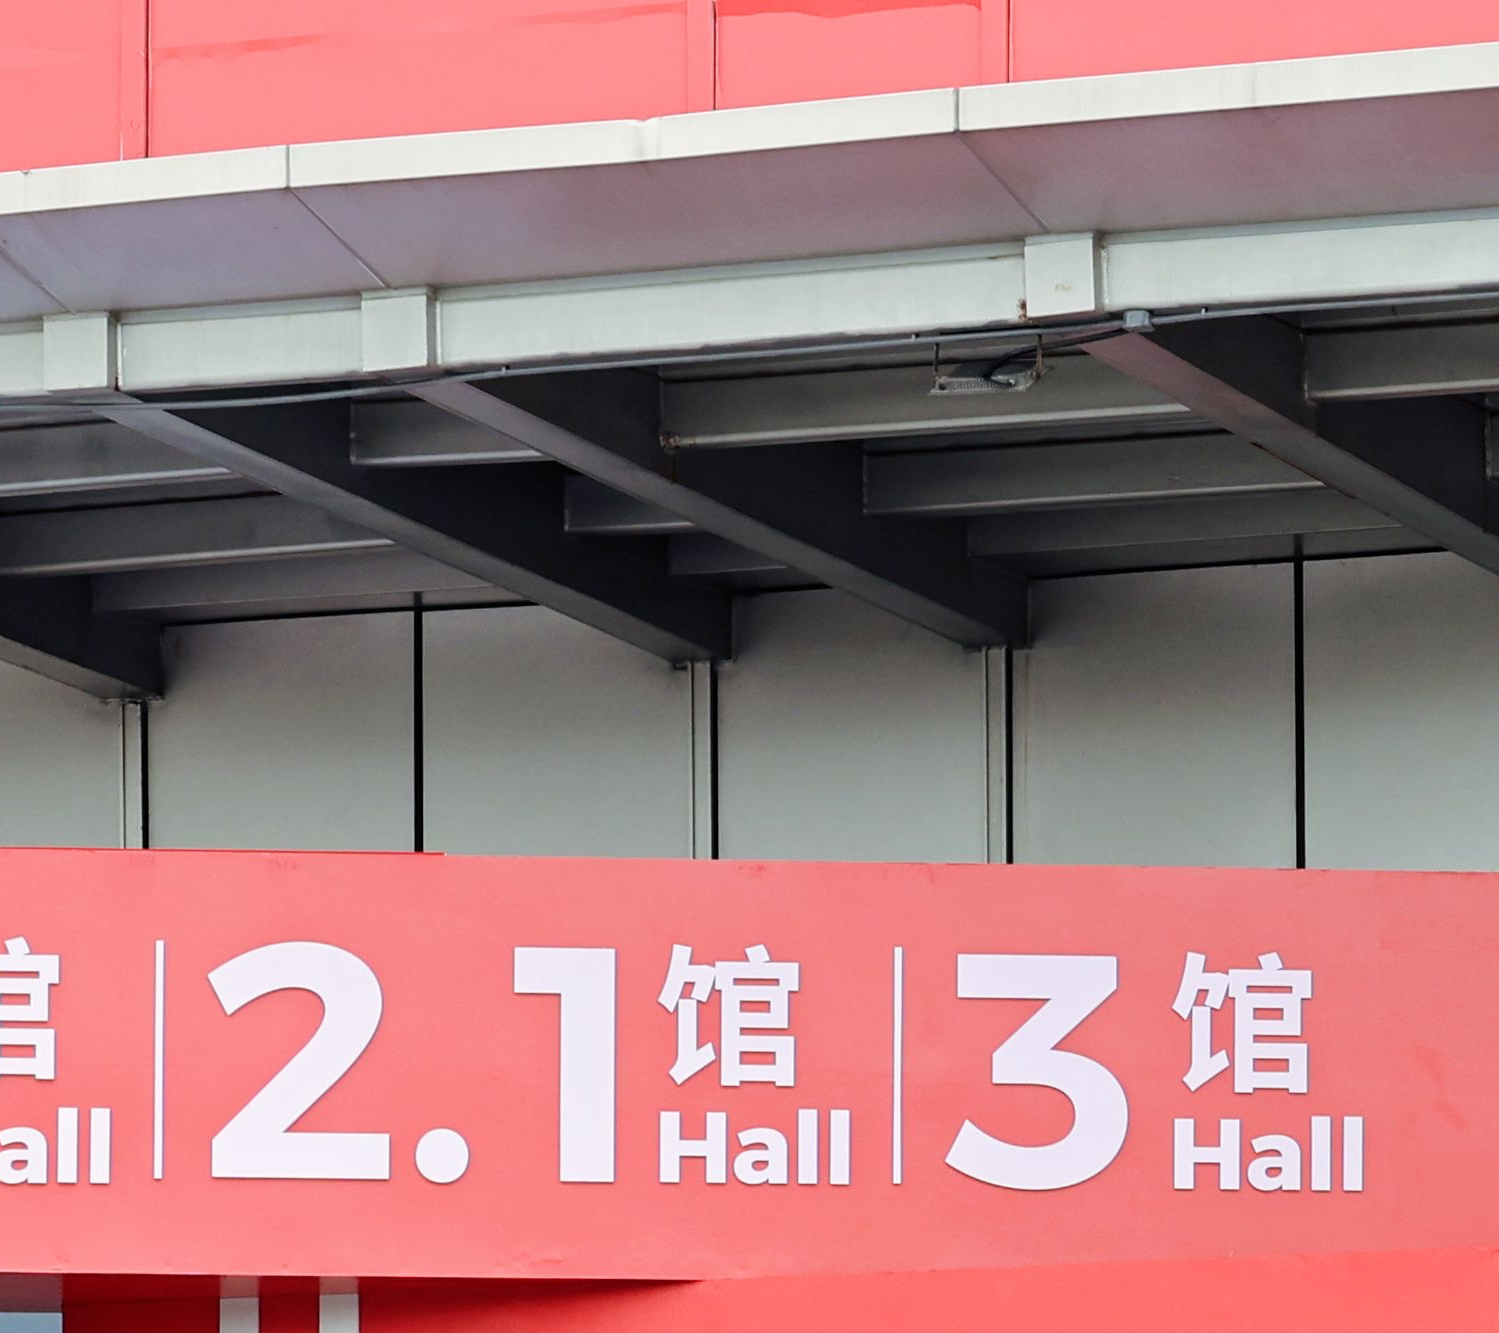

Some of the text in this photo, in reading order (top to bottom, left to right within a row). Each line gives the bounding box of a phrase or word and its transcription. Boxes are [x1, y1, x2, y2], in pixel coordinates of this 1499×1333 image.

[208, 941, 799, 1183] 2.1 馆
[945, 952, 1312, 1189] 3 馆
[659, 1108, 850, 1185] Hall
[1173, 1116, 1363, 1191] Hall
